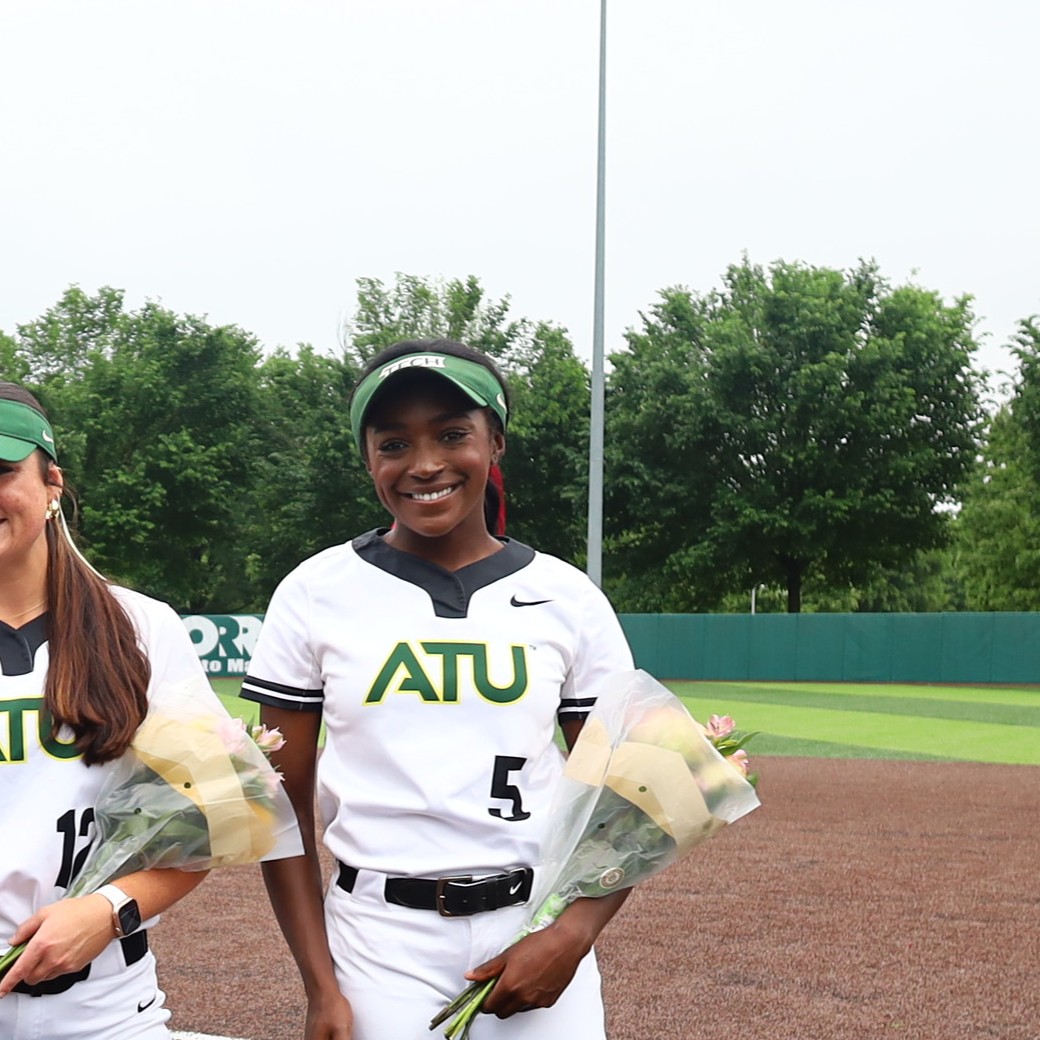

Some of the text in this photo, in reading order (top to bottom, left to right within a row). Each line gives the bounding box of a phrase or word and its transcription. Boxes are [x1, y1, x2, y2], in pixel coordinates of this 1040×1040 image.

[387, 356, 440, 375] TECH
[362, 639, 528, 706] ATU
[487, 754, 532, 822] 5
